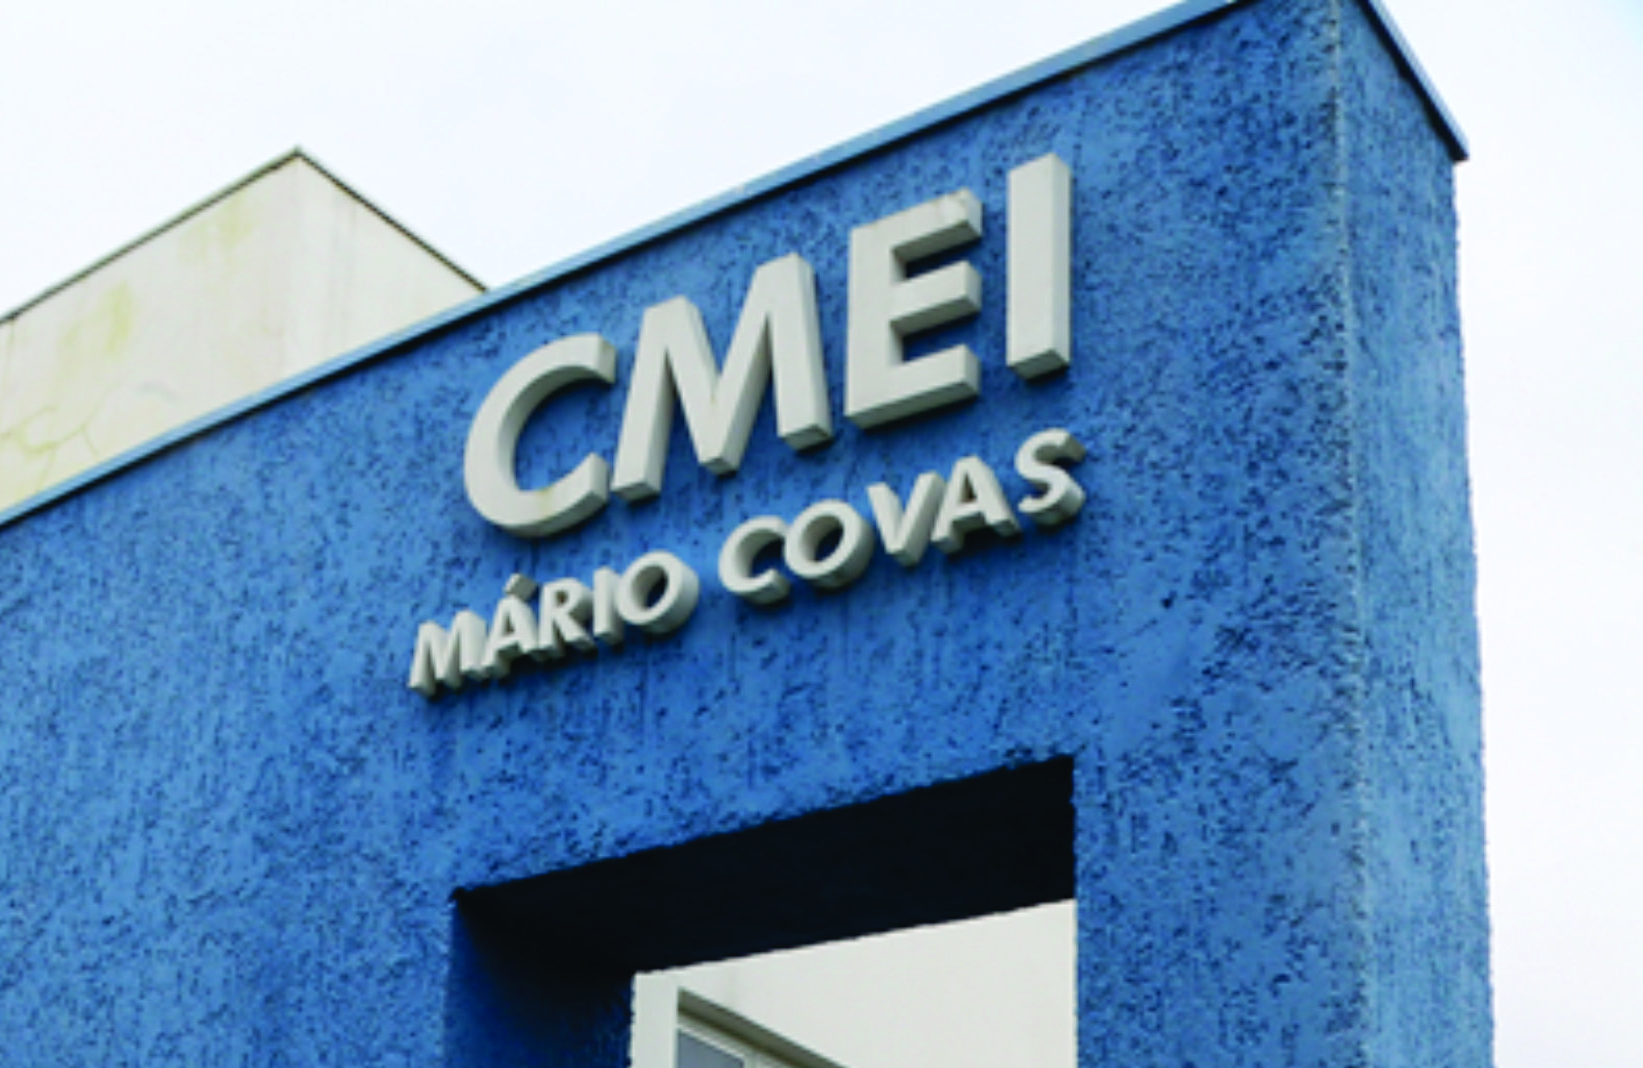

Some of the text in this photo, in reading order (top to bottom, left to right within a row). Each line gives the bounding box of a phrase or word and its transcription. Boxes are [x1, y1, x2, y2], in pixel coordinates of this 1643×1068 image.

[463, 153, 1071, 537] CMEI
[408, 428, 1086, 696] MÁRIO COVAS
